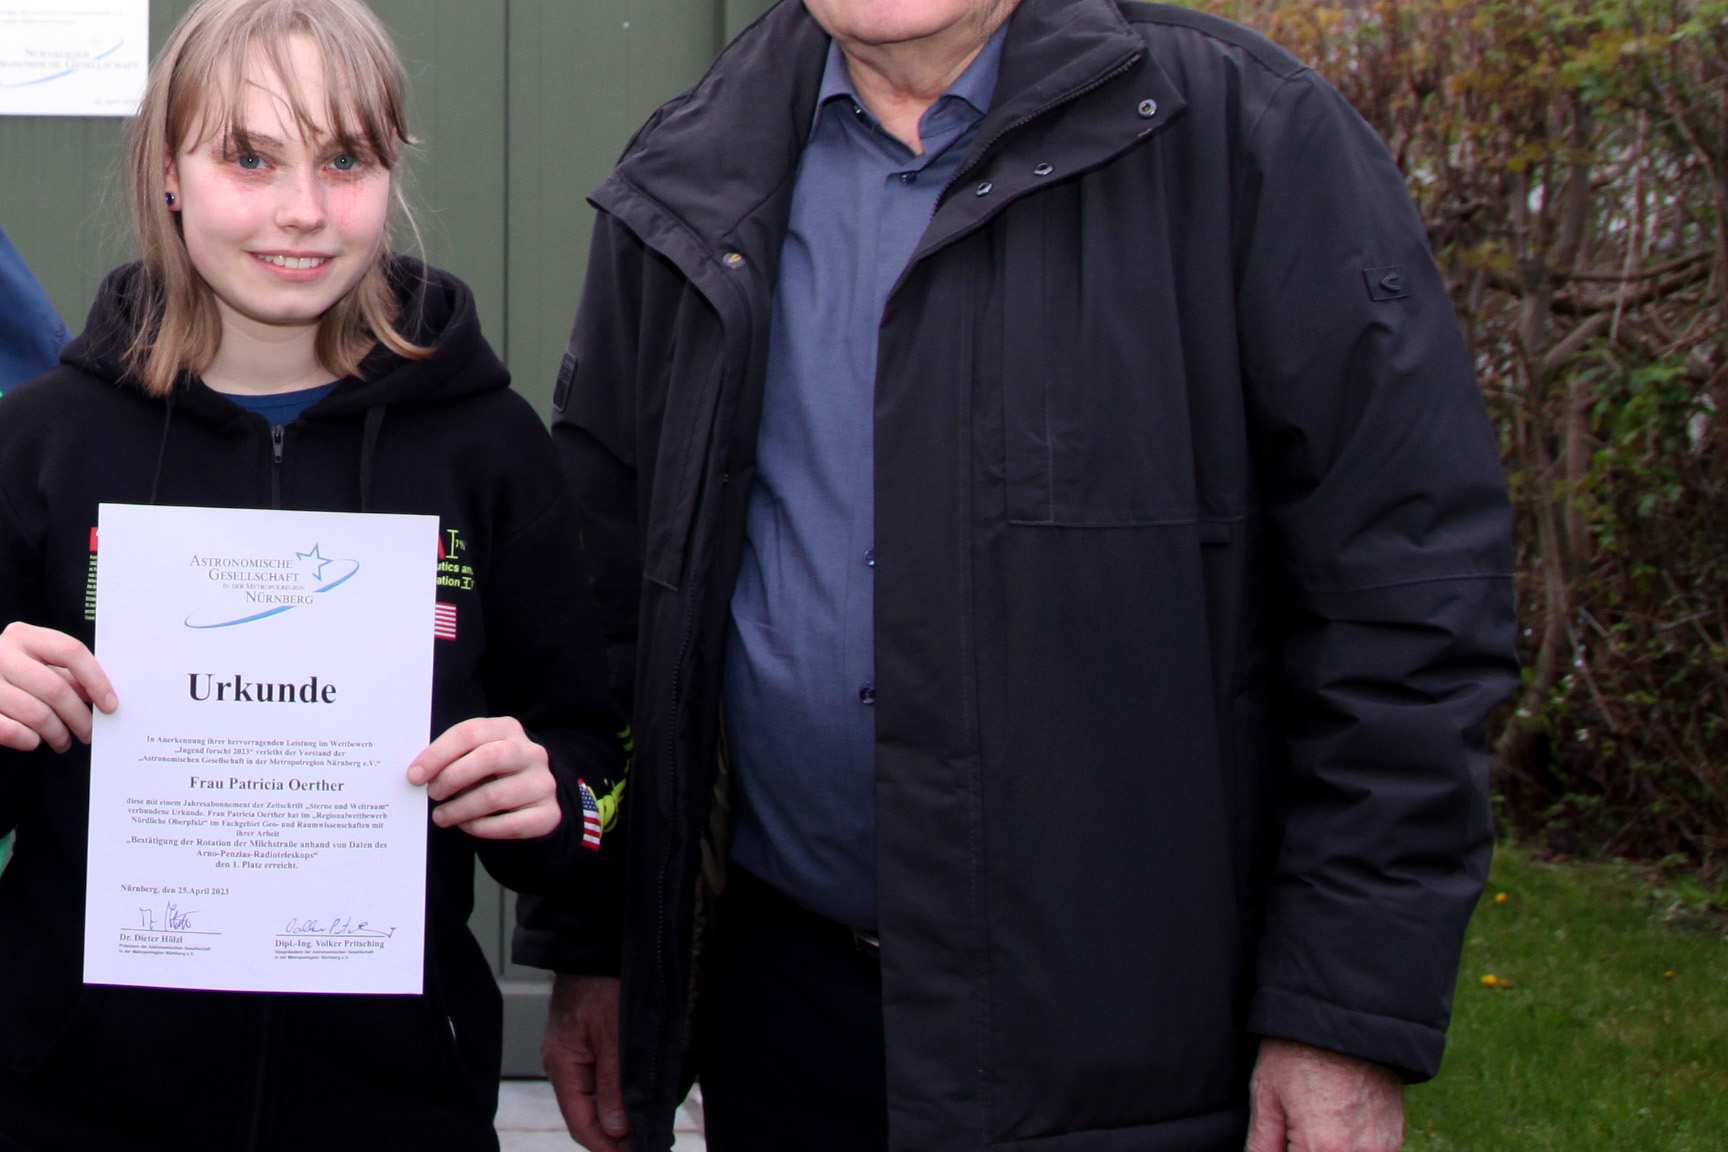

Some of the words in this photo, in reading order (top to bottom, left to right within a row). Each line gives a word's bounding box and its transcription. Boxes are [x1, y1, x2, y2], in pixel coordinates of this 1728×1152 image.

[189, 554, 293, 569] ASTRONOMISCHE
[208, 568, 300, 582] GESELLSCHAFT
[245, 590, 314, 605] NÜRNBERG
[187, 672, 338, 705] Urkunde
[157, 736, 206, 745] Anerkennung
[227, 738, 284, 747] hervorragenden
[286, 740, 317, 748] Leistung
[270, 758, 325, 767] Metropolregion
[327, 759, 361, 768] Nürnberg
[190, 776, 224, 789] Frau
[229, 777, 284, 791] Patricia
[288, 778, 345, 792] Oerther
[183, 800, 250, 808] Jahresabonnement
[131, 816, 166, 824] Nördliche
[222, 820, 260, 828] Fachgebiet
[196, 838, 231, 846] Rotation
[250, 840, 298, 848] Milchstraße
[121, 884, 160, 894] Nürnberg,
[134, 934, 159, 942] Dieter
[344, 940, 385, 948] Pritsching
